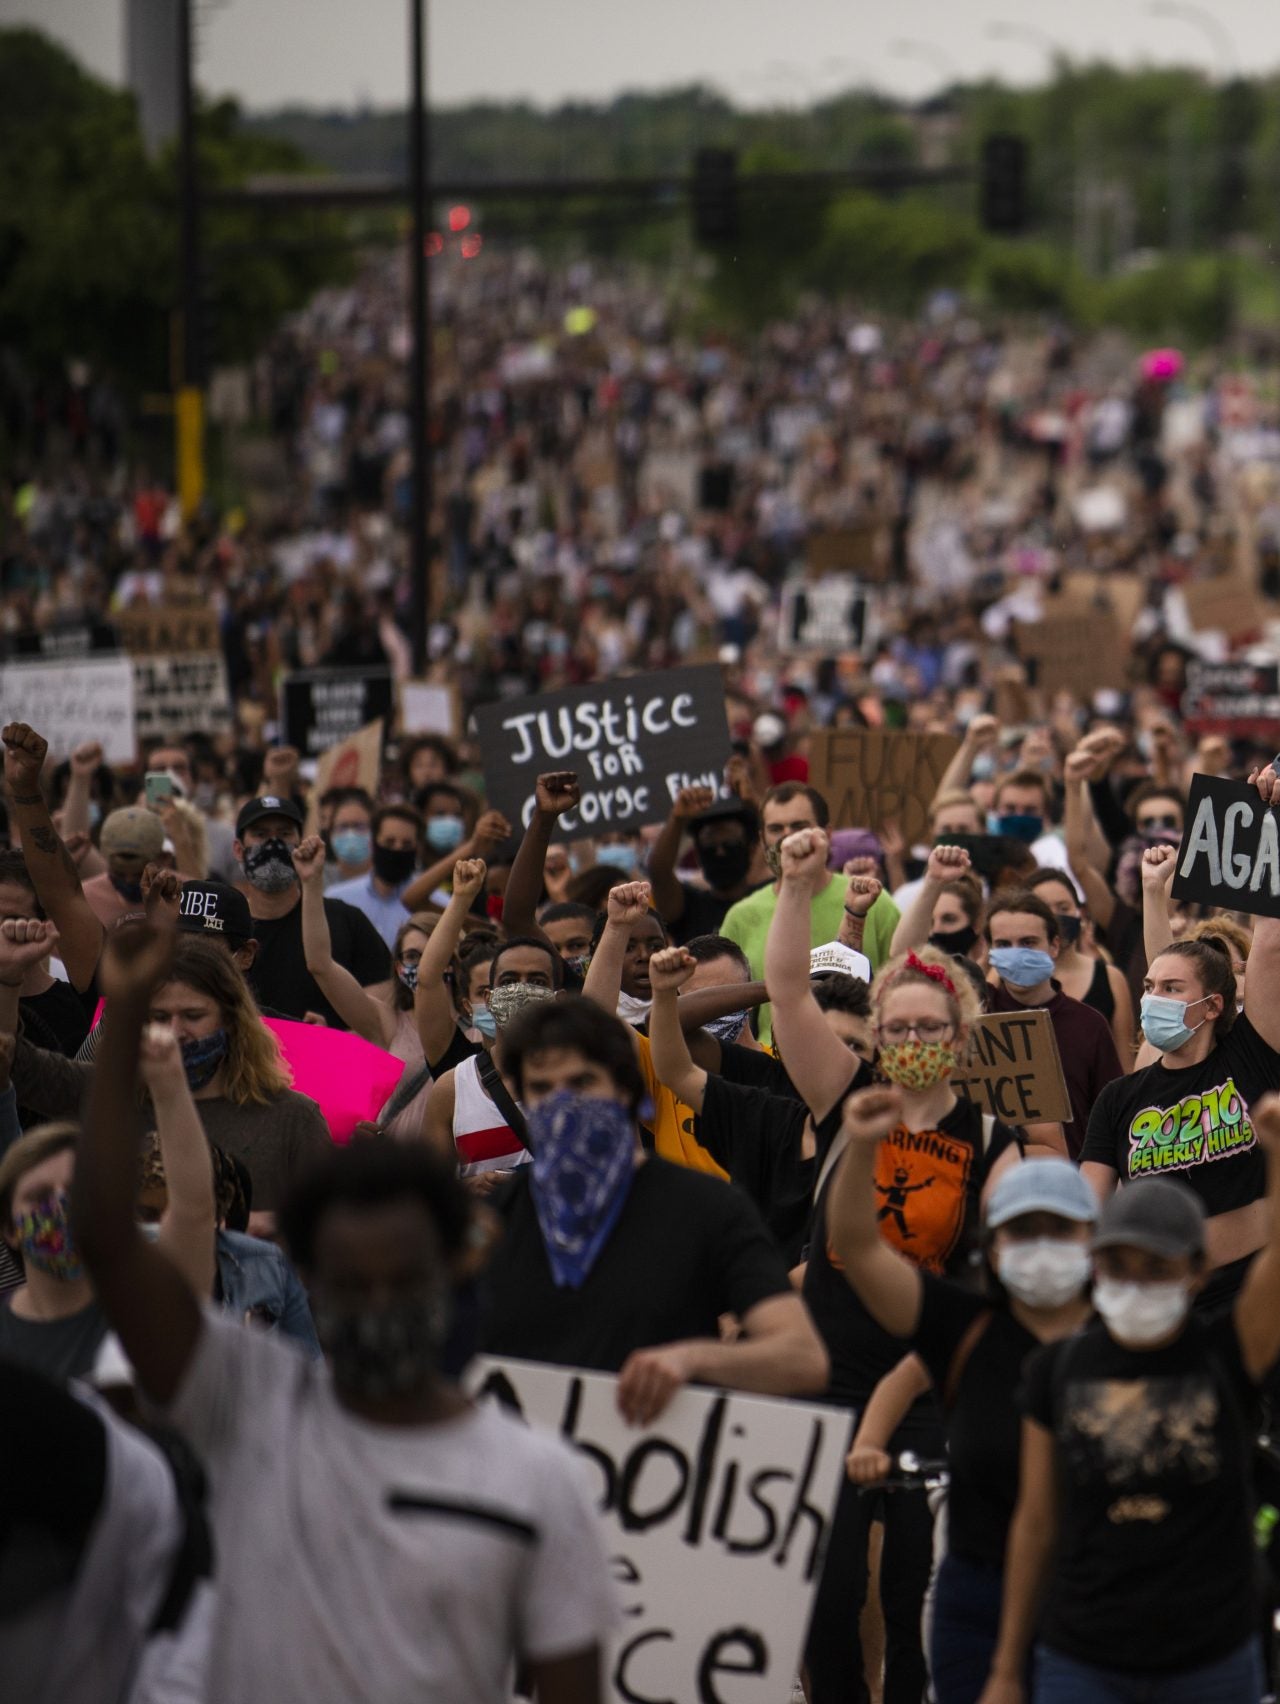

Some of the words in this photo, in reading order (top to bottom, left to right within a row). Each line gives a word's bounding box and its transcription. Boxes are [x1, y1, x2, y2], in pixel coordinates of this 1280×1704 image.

[827, 731, 941, 791] FUCK
[966, 1018, 1038, 1068] ANT
[950, 1072, 1042, 1119] TICE
[1129, 1077, 1243, 1149] 90210
[886, 1130, 961, 1164] RNING
[1130, 1135, 1204, 1174] BEVERLY
[1206, 1120, 1254, 1156] HILLS
